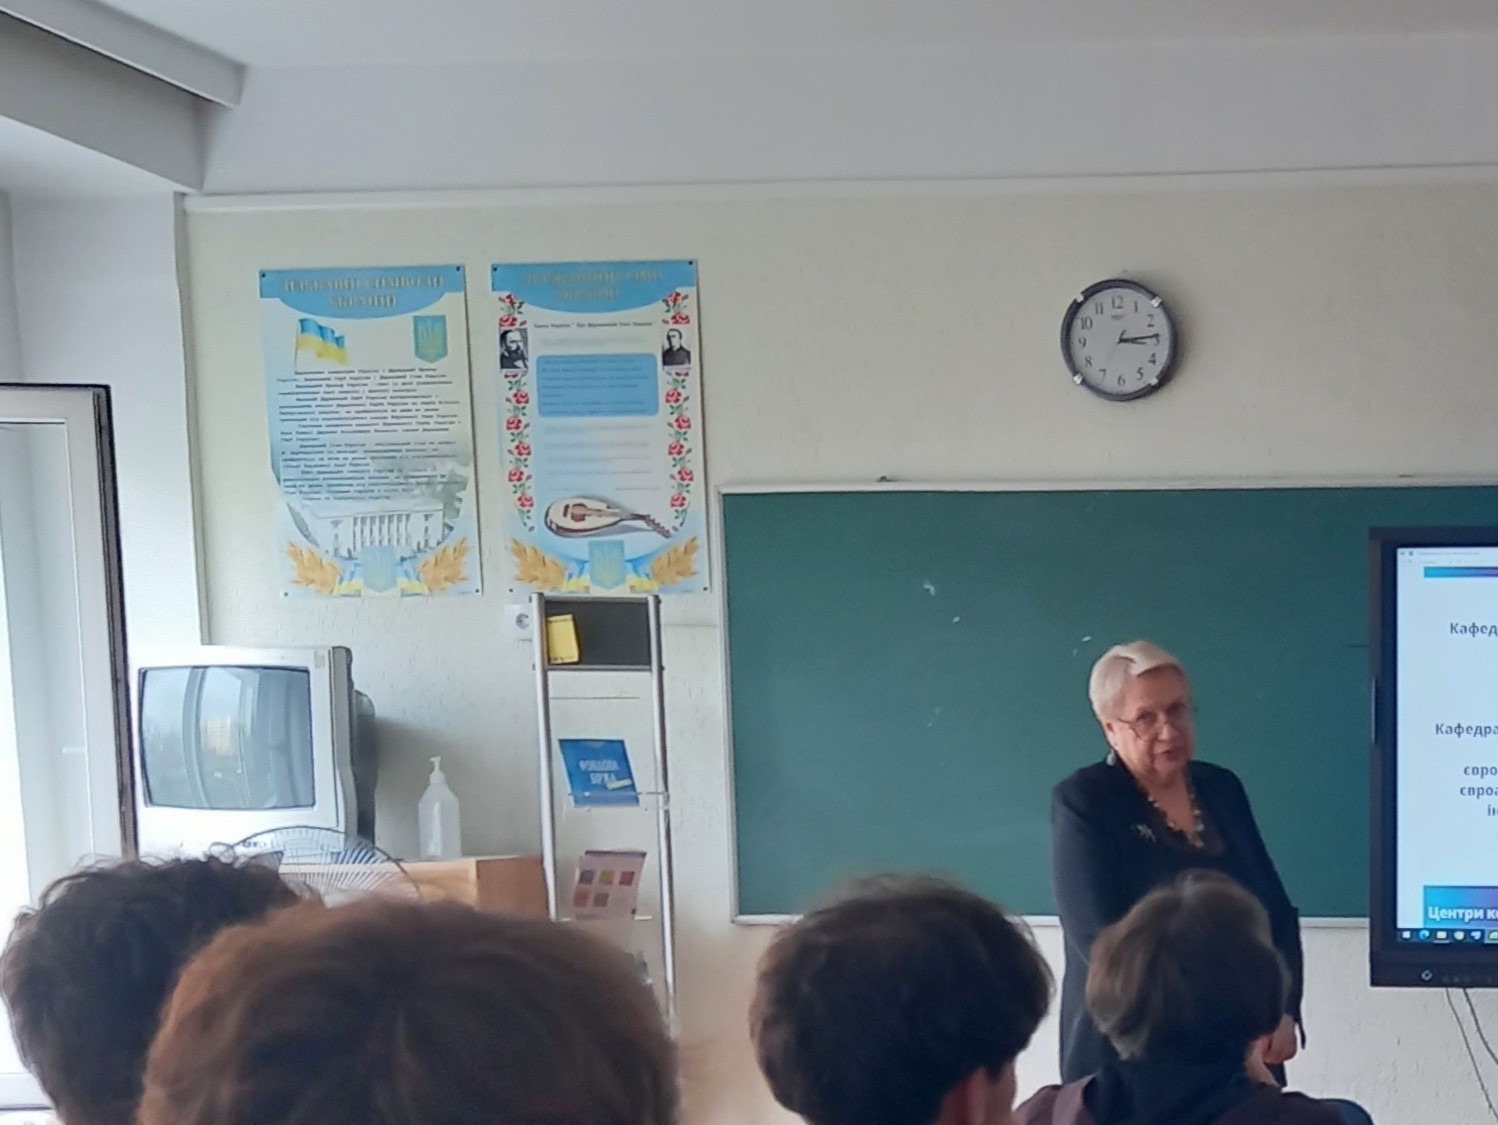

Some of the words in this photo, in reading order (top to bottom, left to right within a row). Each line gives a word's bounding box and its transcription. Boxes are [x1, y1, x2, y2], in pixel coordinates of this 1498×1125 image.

[1095, 302, 1104, 315] 11
[1111, 295, 1124, 310] 12
[1080, 316, 1093, 330] 10
[1146, 314, 1155, 328] 2
[1078, 337, 1087, 349] 9
[1084, 355, 1093, 367] 8
[1148, 352, 1157, 366] 4
[1099, 368, 1107, 382] 7
[1117, 375, 1126, 387] 6
[1136, 367, 1145, 381] 5
[1427, 905, 1485, 923] Центри
